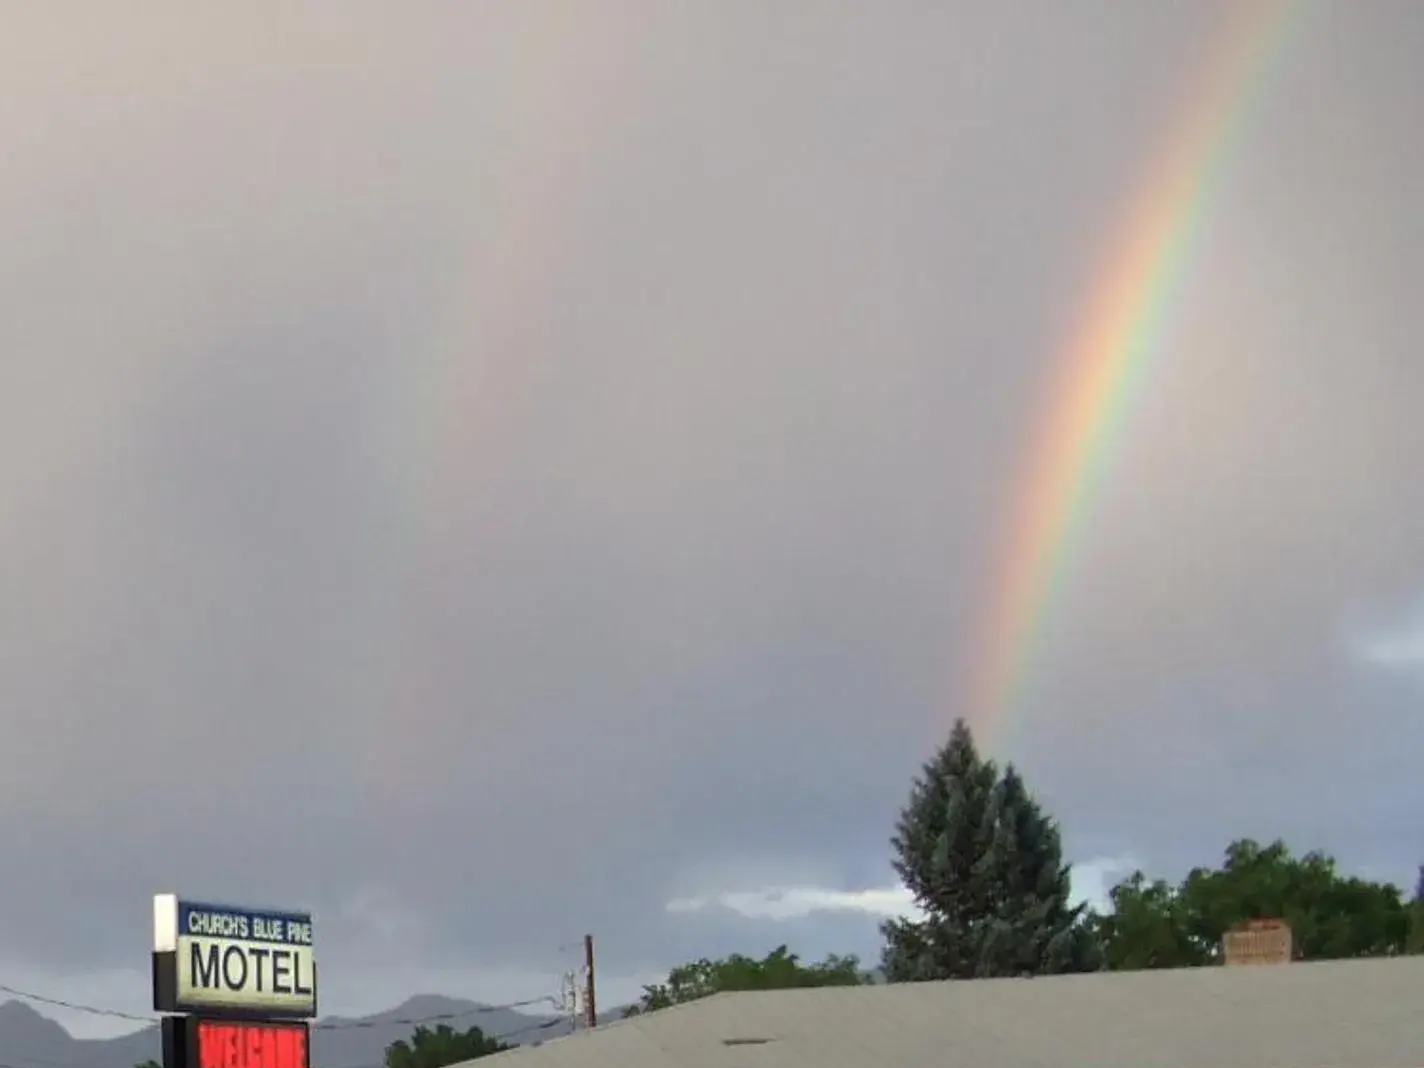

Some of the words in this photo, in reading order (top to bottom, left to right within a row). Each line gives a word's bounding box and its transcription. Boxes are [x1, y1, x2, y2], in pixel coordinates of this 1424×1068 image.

[188, 911, 249, 937] CHURCH'S
[253, 917, 284, 940] BLUE
[287, 921, 312, 943] PINE
[191, 942, 312, 994] MOTEL
